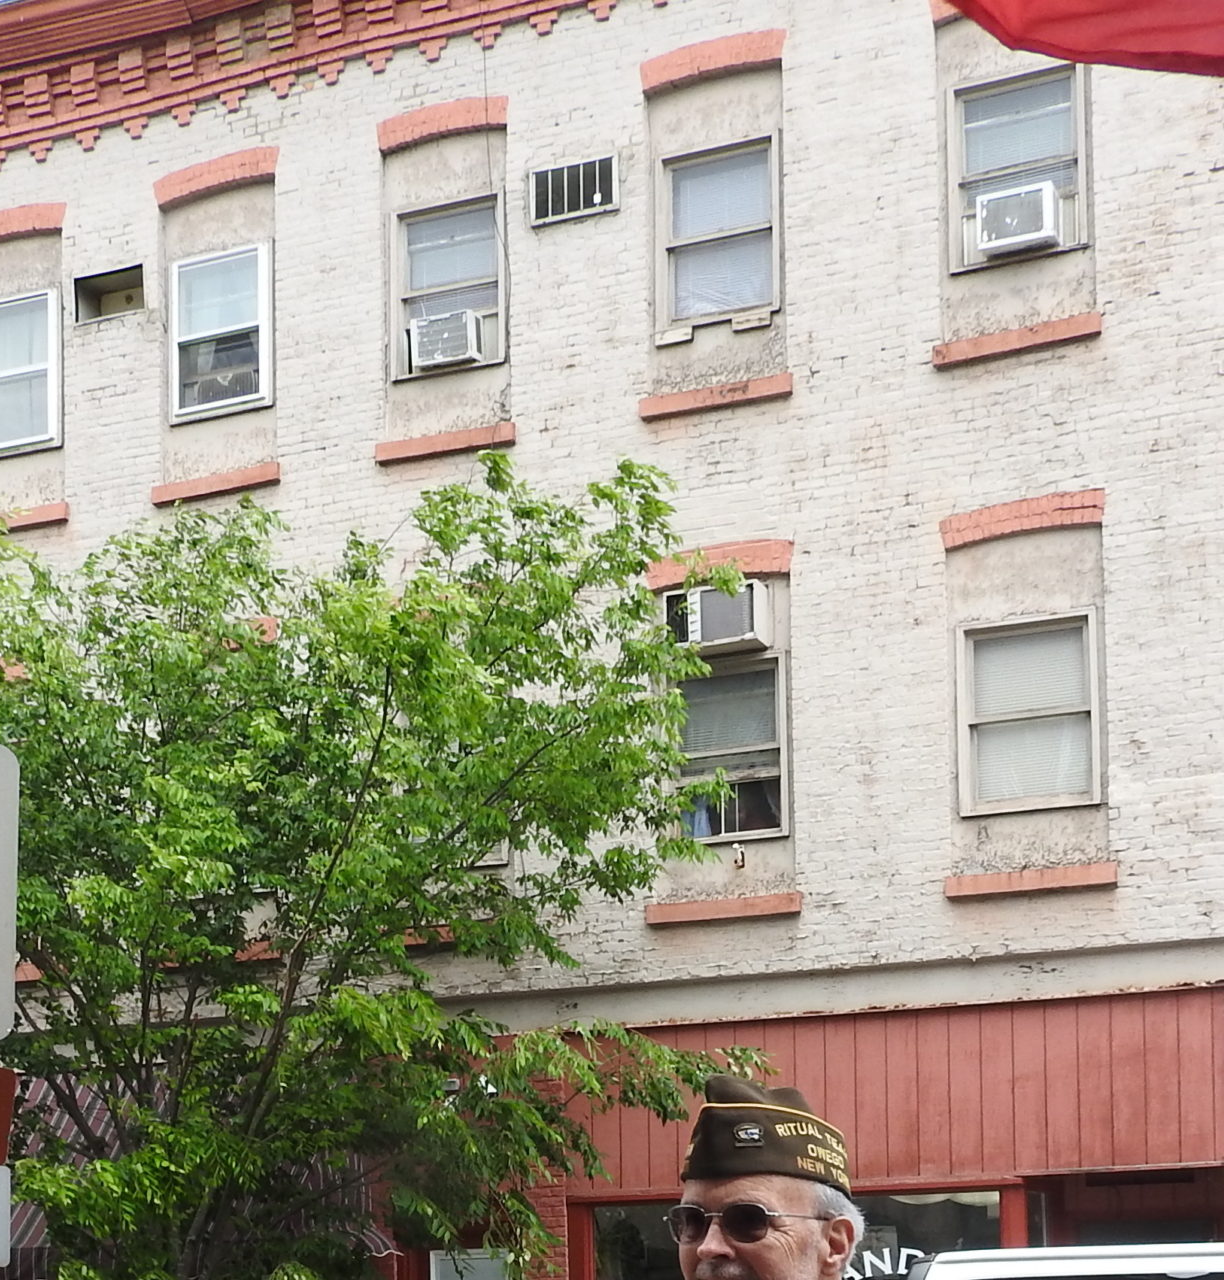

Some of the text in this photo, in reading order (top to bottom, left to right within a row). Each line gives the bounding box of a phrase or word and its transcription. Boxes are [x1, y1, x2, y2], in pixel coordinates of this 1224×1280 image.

[775, 1122, 823, 1139] RITUAL
[797, 1156, 825, 1175] NEW
[807, 1144, 845, 1169] OWEGO
